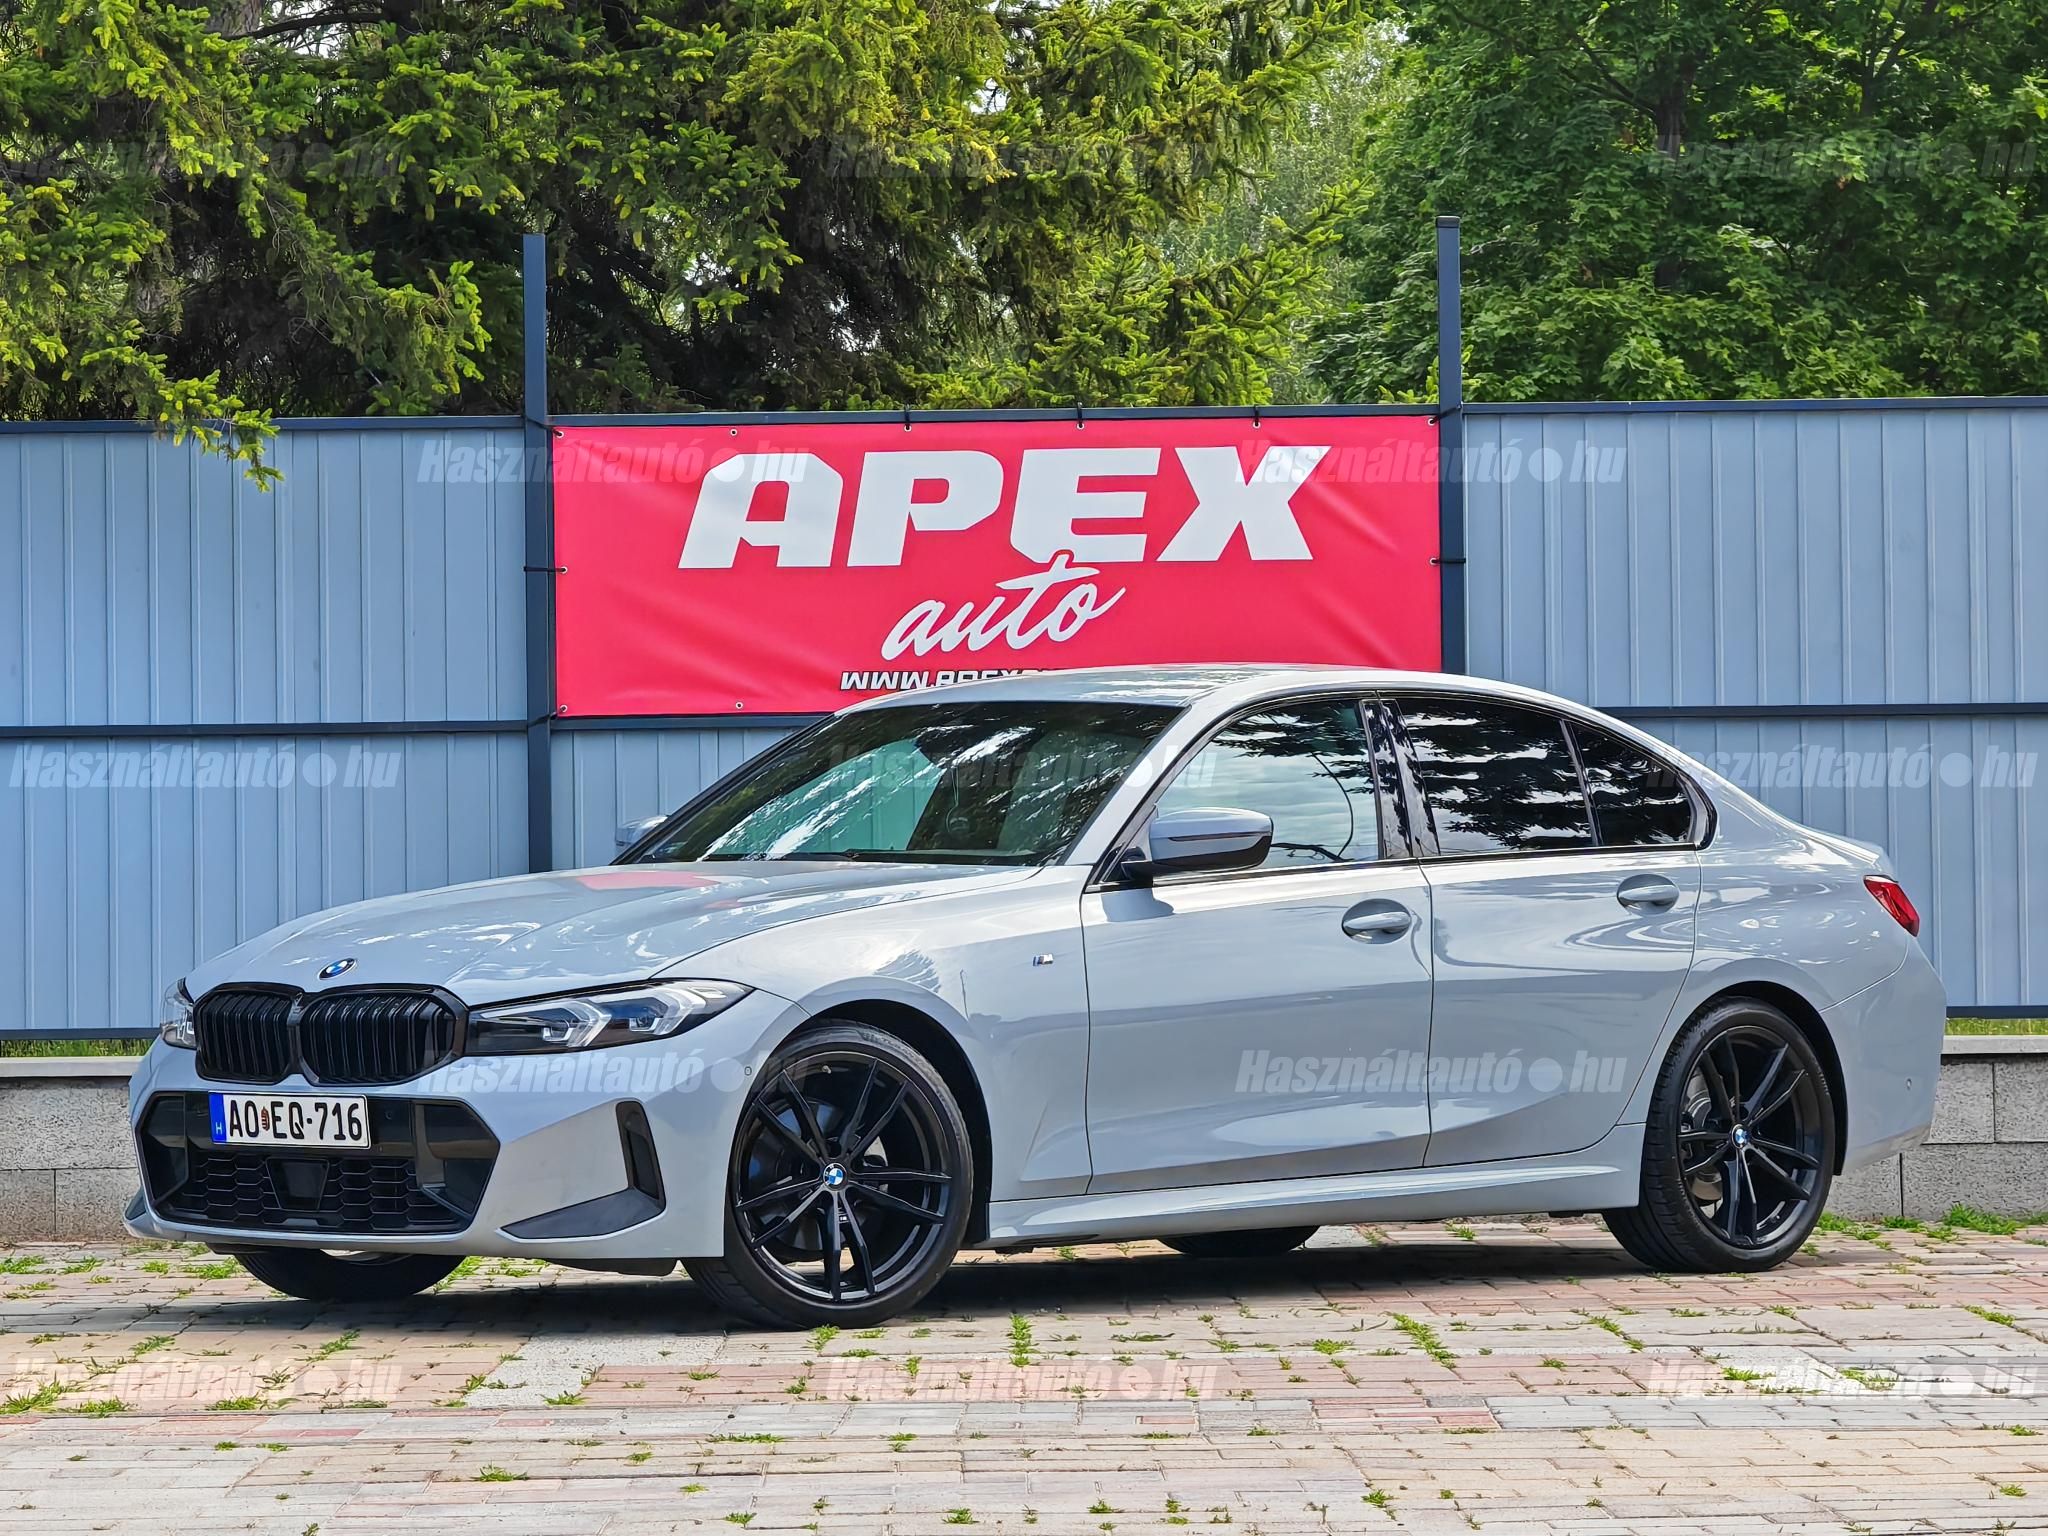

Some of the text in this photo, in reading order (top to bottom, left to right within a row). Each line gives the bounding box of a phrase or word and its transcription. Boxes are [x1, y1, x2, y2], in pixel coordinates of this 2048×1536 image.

[678, 445, 1332, 569] APEX
[881, 553, 1126, 661] auto
[229, 1100, 260, 1138] AO
